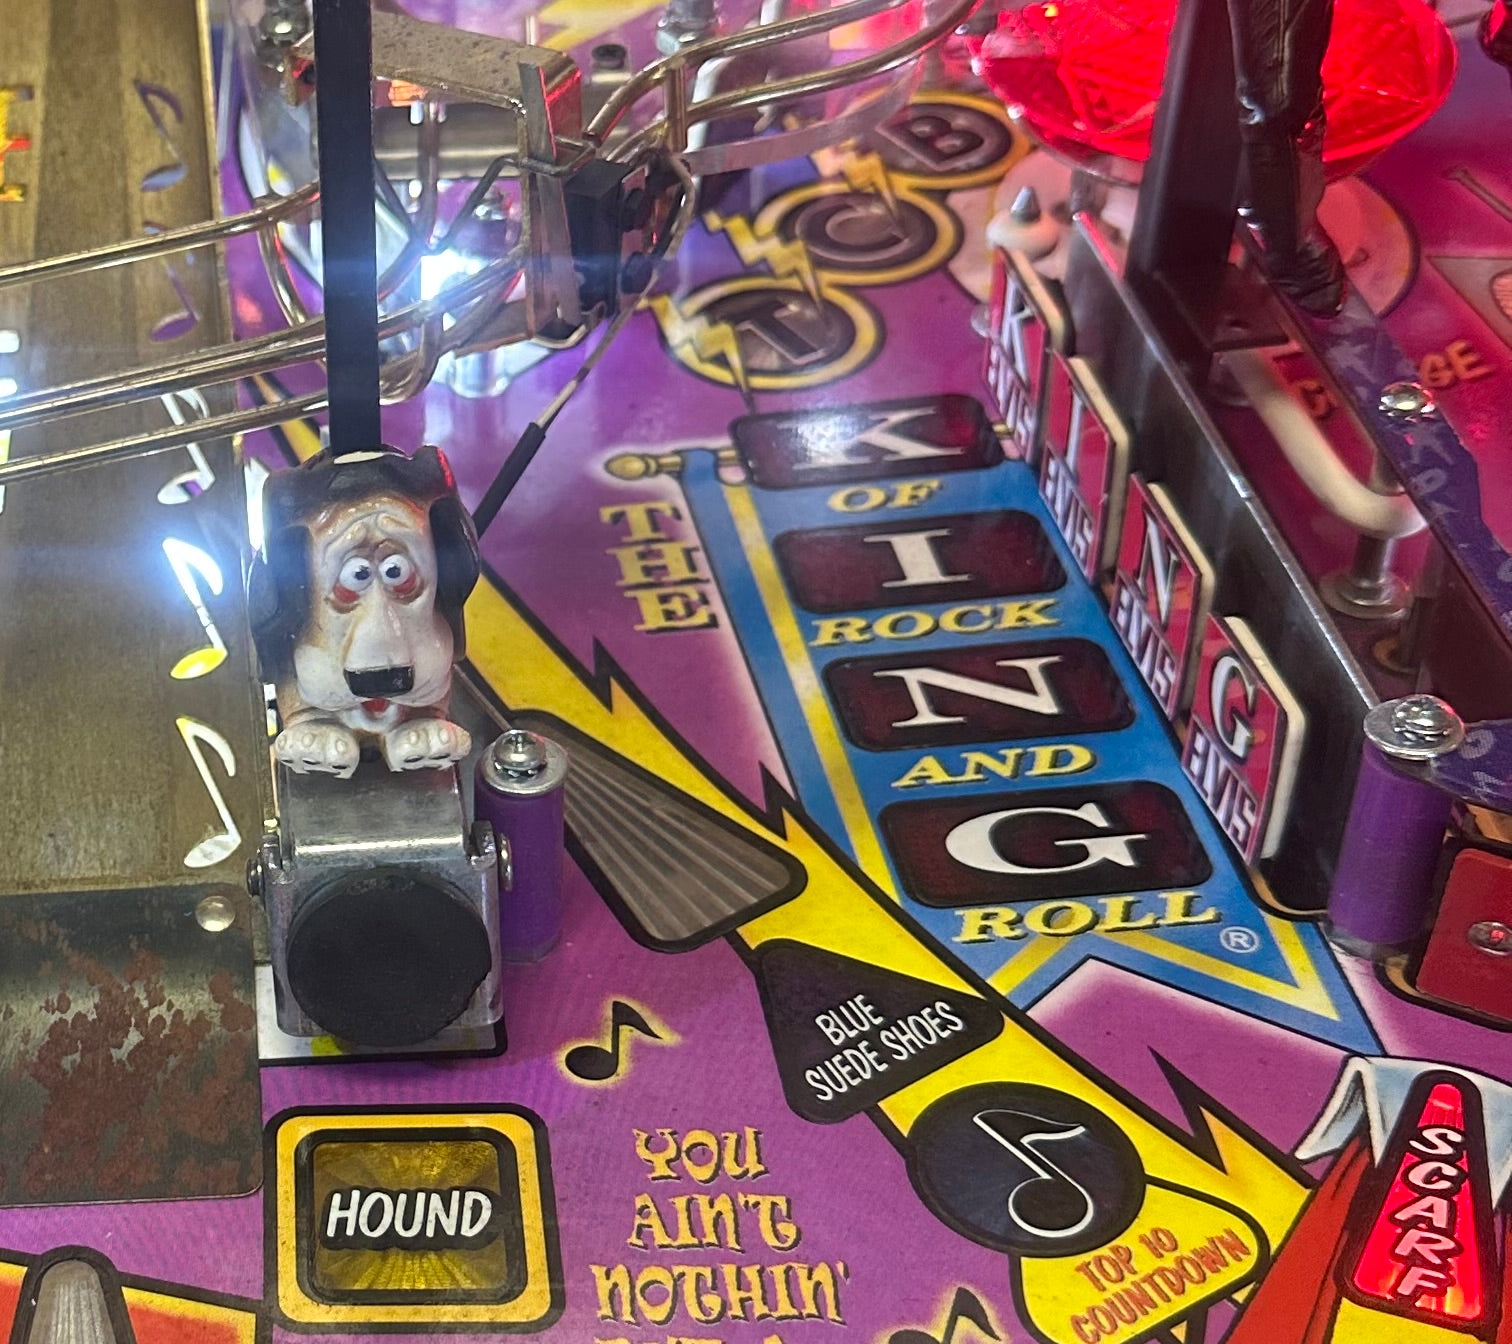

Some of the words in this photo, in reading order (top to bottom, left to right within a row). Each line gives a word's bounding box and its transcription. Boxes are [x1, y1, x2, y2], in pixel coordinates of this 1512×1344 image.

[828, 479, 945, 513] OF
[809, 599, 1061, 647] ROCK
[1116, 583, 1175, 711] ELVIS
[890, 743, 1097, 790] AND
[1190, 730, 1255, 854] ELVIS
[951, 891, 1224, 945] ROLL
[815, 994, 884, 1046] BLUE
[805, 1040, 889, 1101] SUEDE
[879, 1001, 964, 1061] SHOES
[631, 1126, 770, 1184] YOU
[325, 1188, 492, 1240] HOUND
[1393, 1126, 1465, 1297] SCARF
[1075, 1244, 1138, 1292] TOP
[1139, 1226, 1179, 1259] 10
